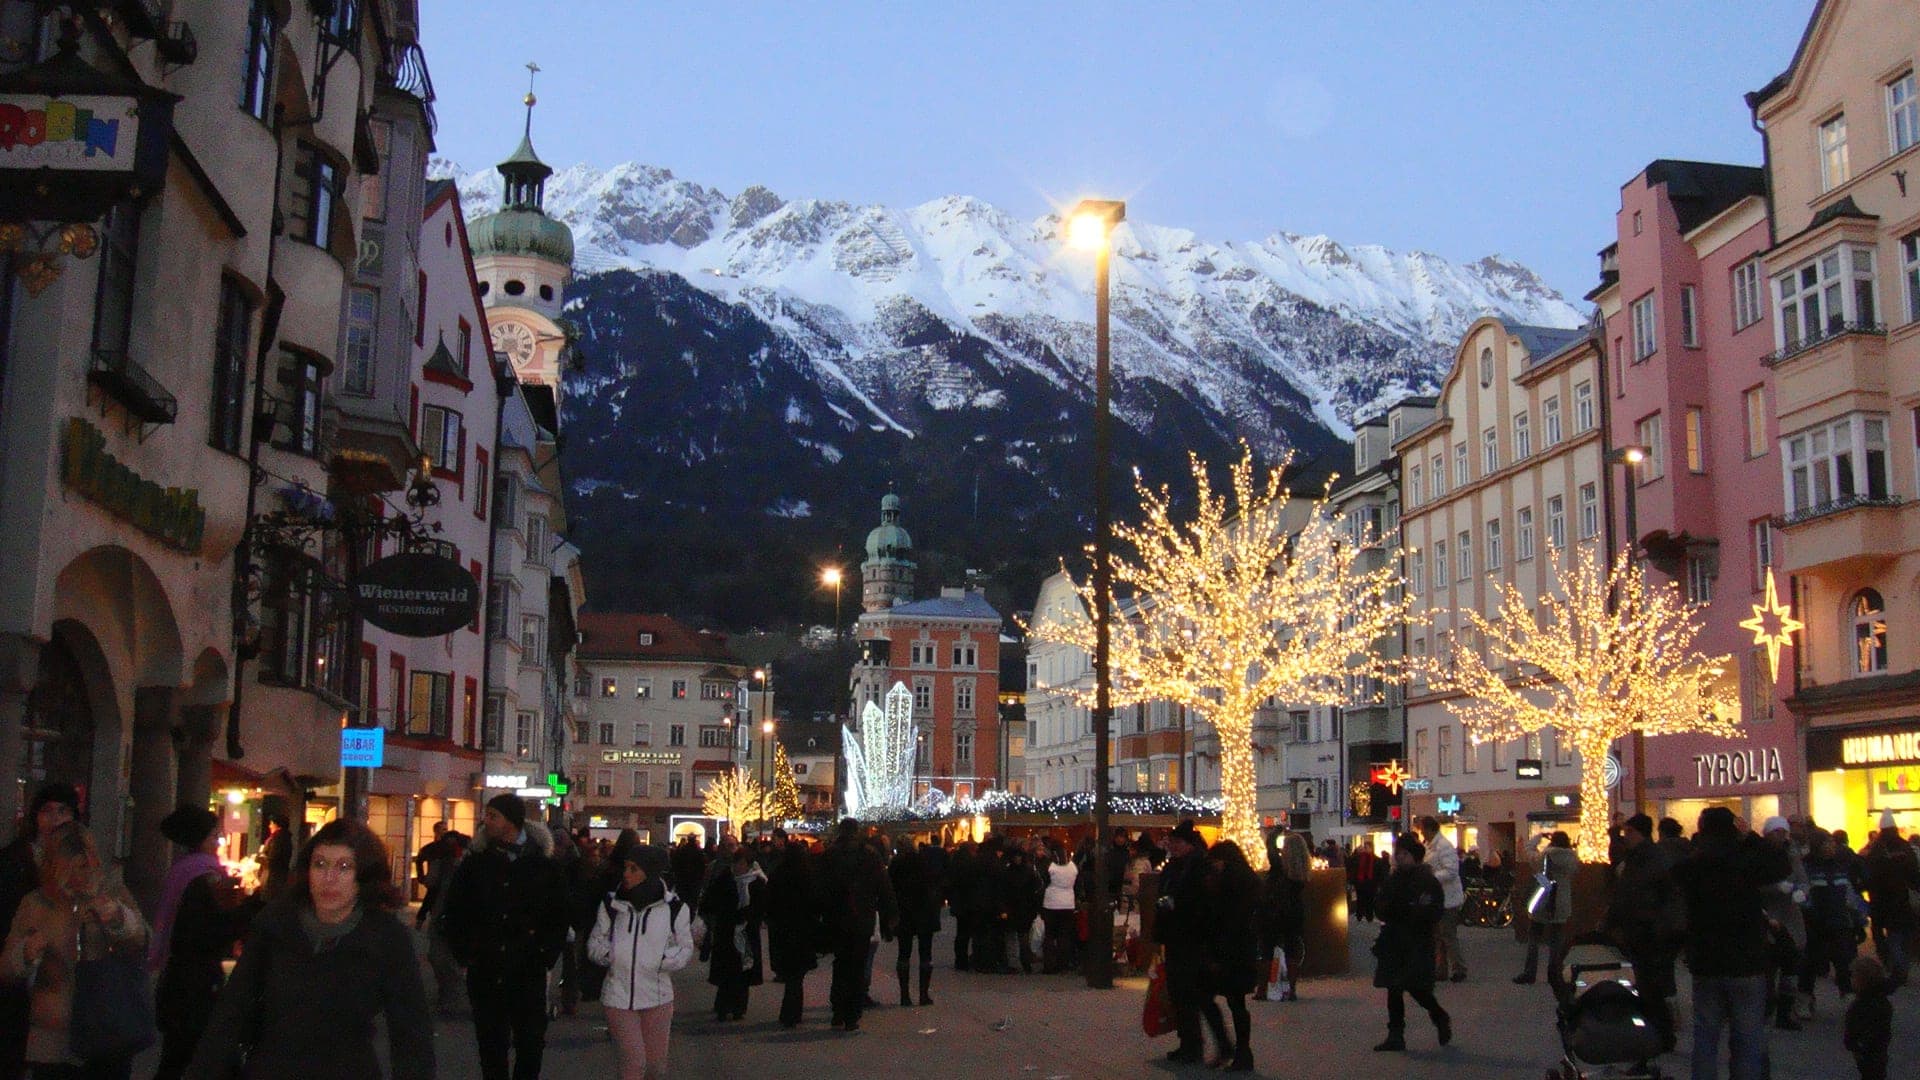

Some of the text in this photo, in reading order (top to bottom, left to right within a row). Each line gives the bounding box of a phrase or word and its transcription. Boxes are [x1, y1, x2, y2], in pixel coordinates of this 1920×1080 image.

[358, 584, 468, 602] Wienerwald
[378, 604, 446, 616] RESTAURANT
[622, 750, 681, 759] donau
[1843, 732, 1920, 764] HUMANIC
[1693, 747, 1784, 787] TYROLIA
